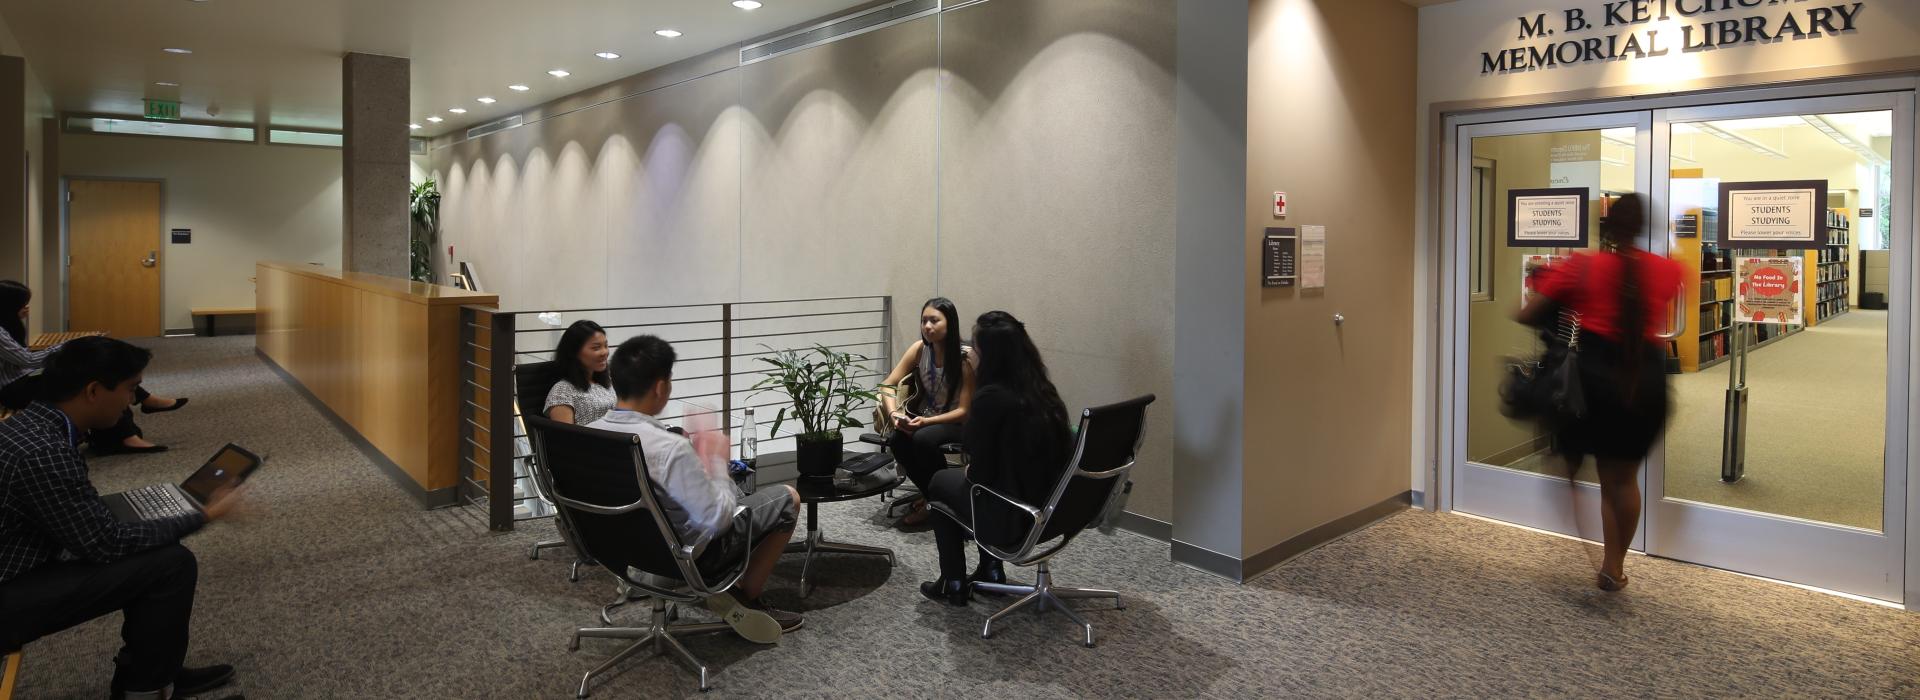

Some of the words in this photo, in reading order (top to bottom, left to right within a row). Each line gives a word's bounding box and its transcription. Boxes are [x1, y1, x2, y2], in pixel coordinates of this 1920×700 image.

[1518, 13, 1553, 39] M.
[1564, 8, 1592, 32] B.
[1480, 30, 1669, 74] MEMORIAL
[1681, 2, 1864, 51] LIBRARY
[150, 100, 179, 116] EXIT
[1751, 206, 1791, 214] STUDENTS
[1751, 217, 1791, 225] STUDYING
